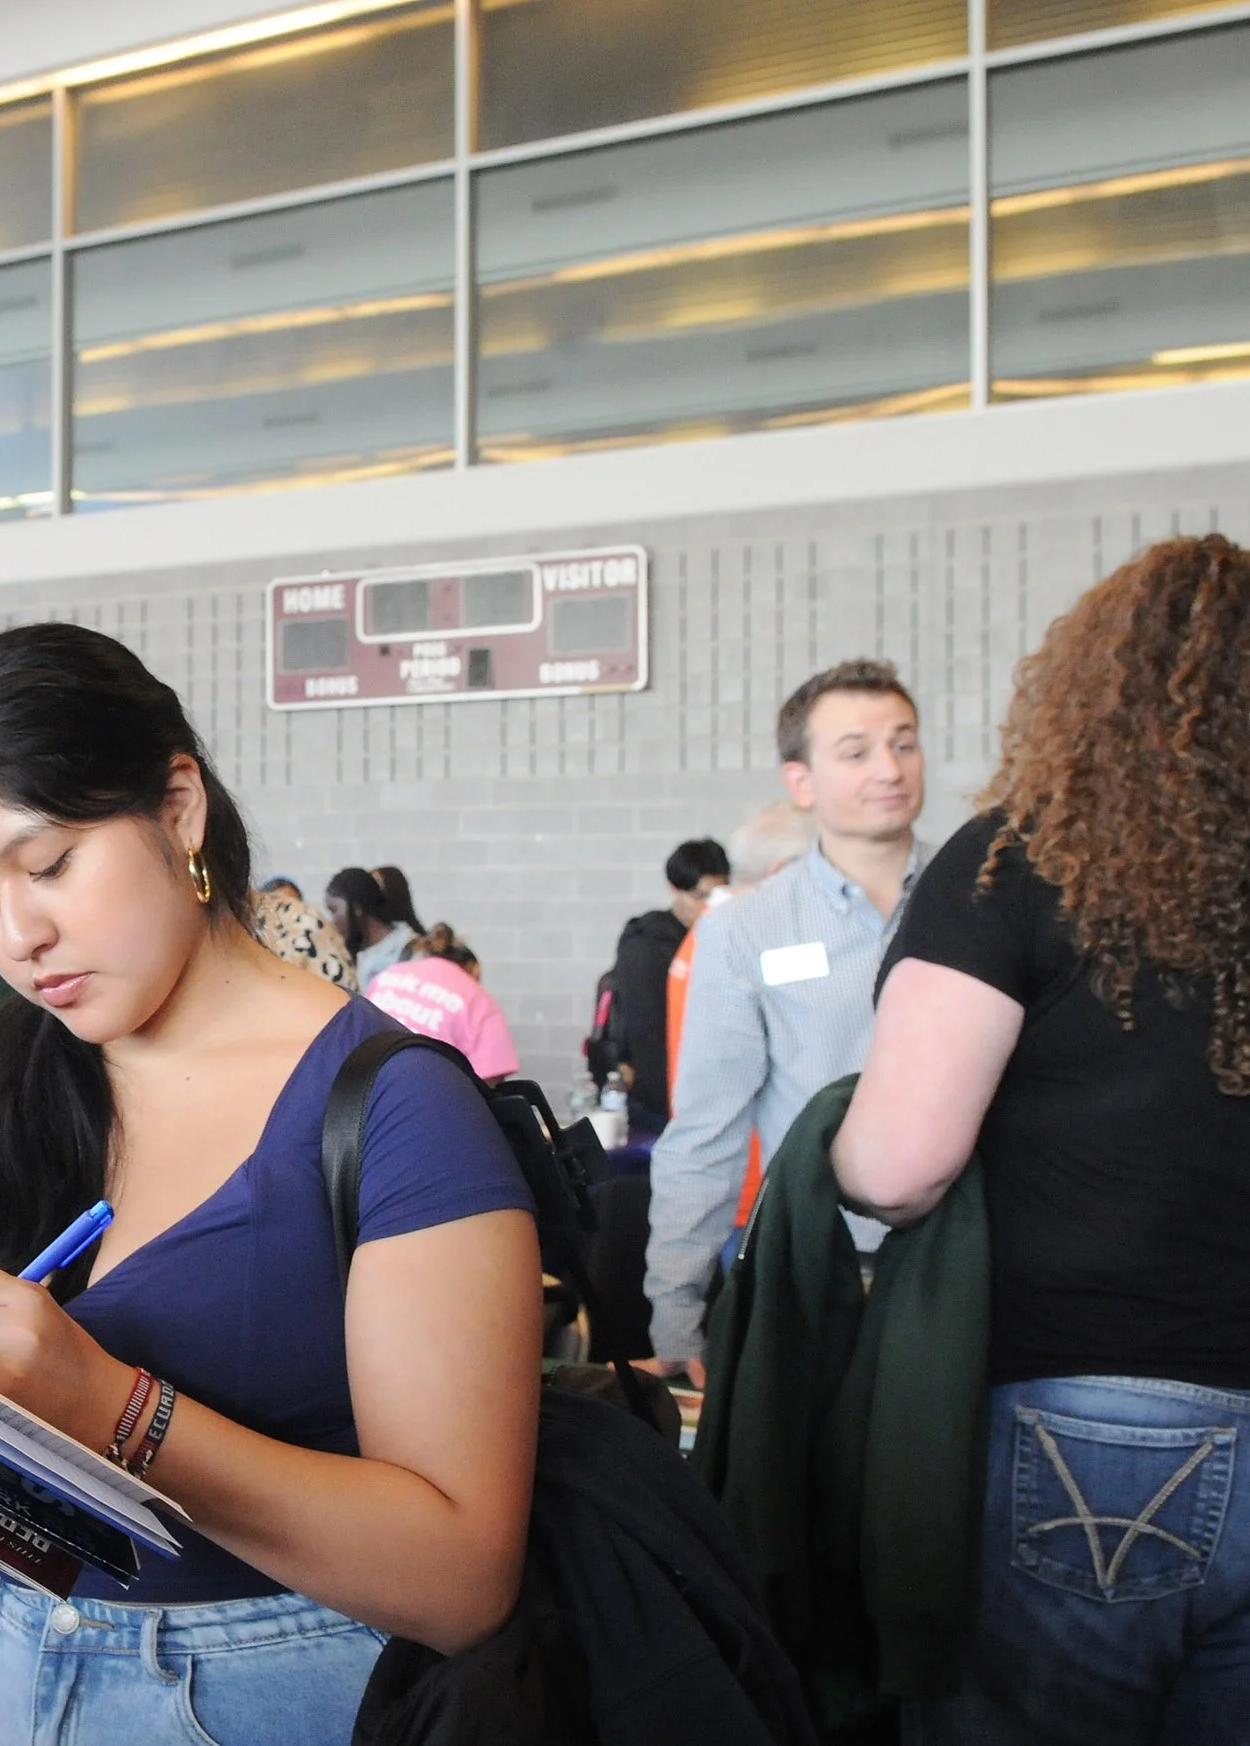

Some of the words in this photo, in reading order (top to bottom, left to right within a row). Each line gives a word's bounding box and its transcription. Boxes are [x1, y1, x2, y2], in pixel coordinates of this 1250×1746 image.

[542, 558, 637, 591] VISITOR
[283, 585, 346, 613] HOME
[399, 656, 461, 680] PERIOD
[418, 982, 464, 1013] me
